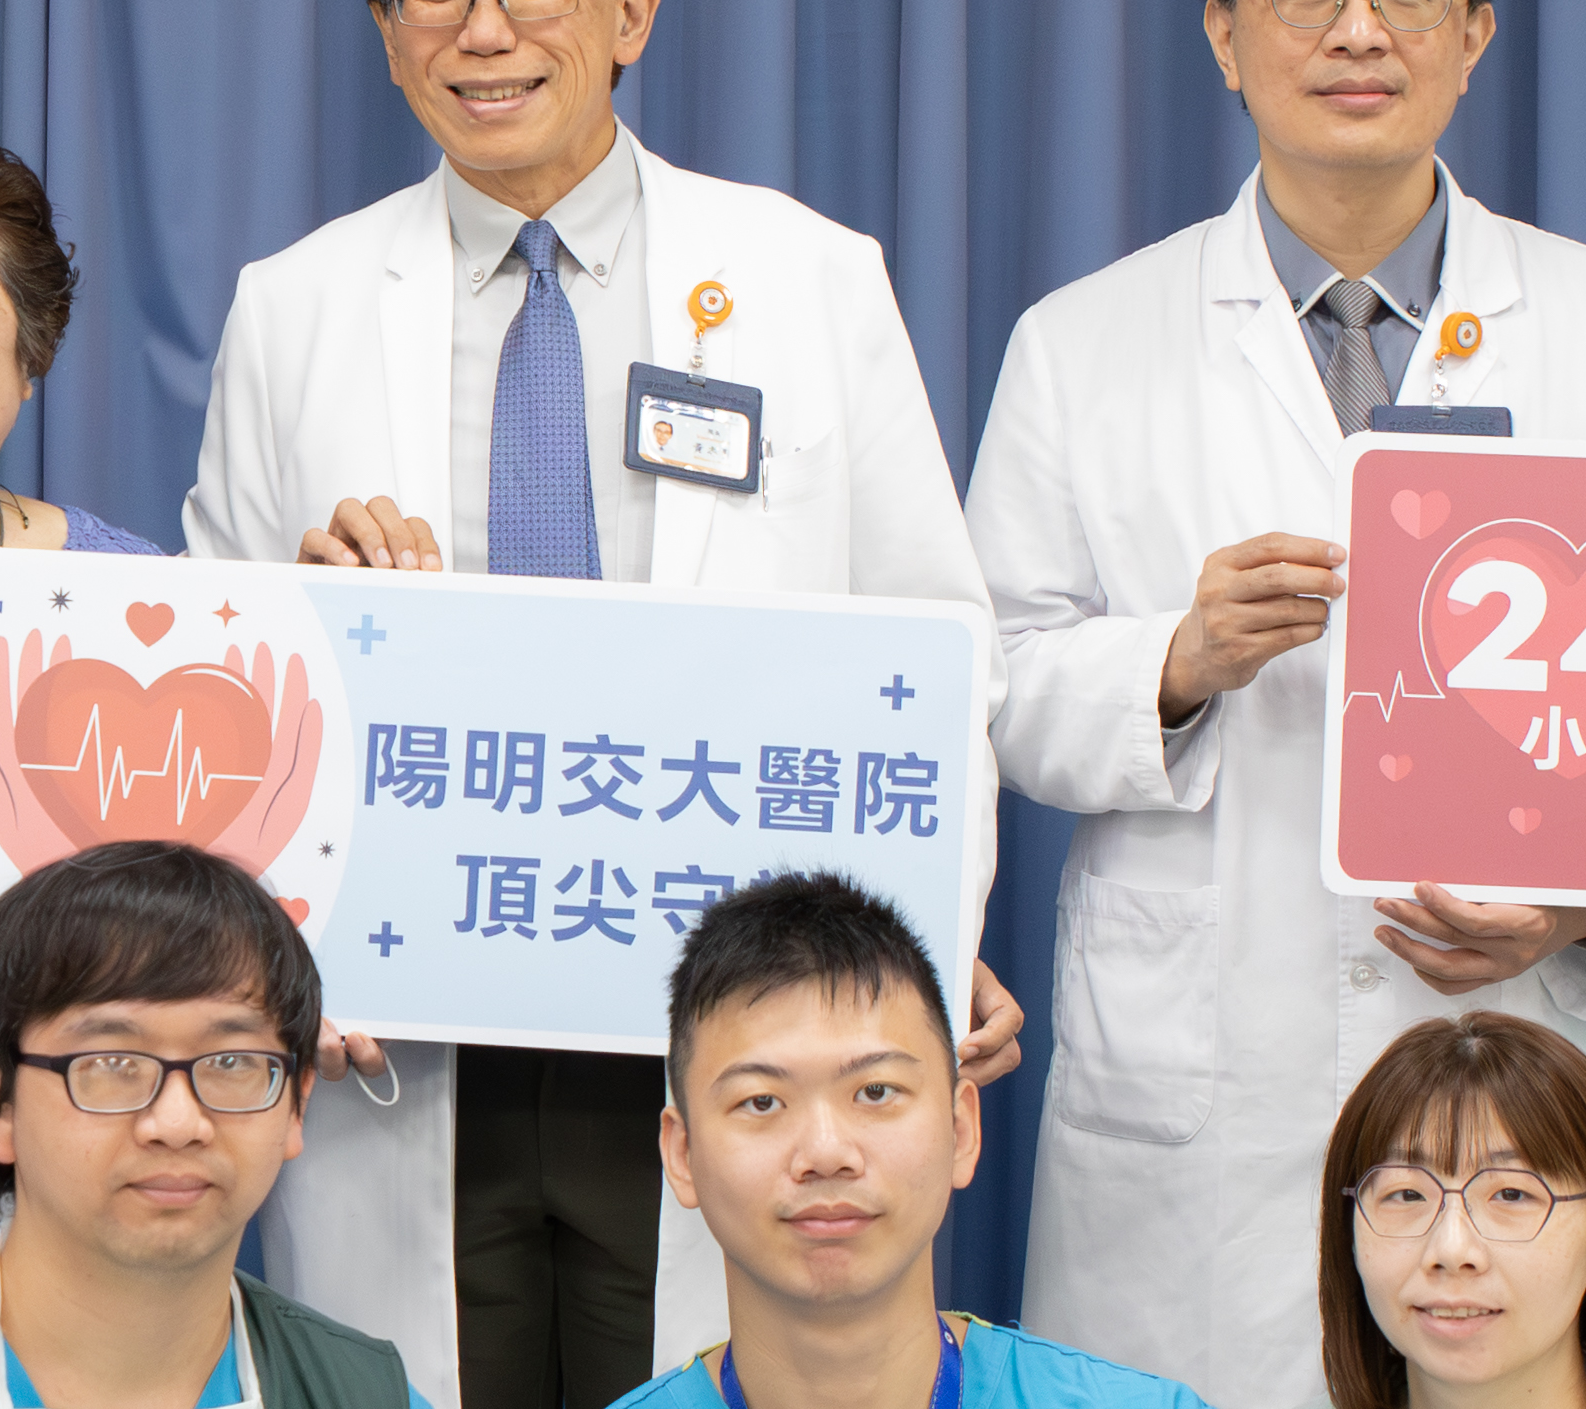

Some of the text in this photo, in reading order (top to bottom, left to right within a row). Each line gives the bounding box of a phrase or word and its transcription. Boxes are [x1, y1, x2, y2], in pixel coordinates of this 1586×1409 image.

[364, 723, 940, 838] 陽明交大醫院
[452, 854, 808, 947] 頂尖守
